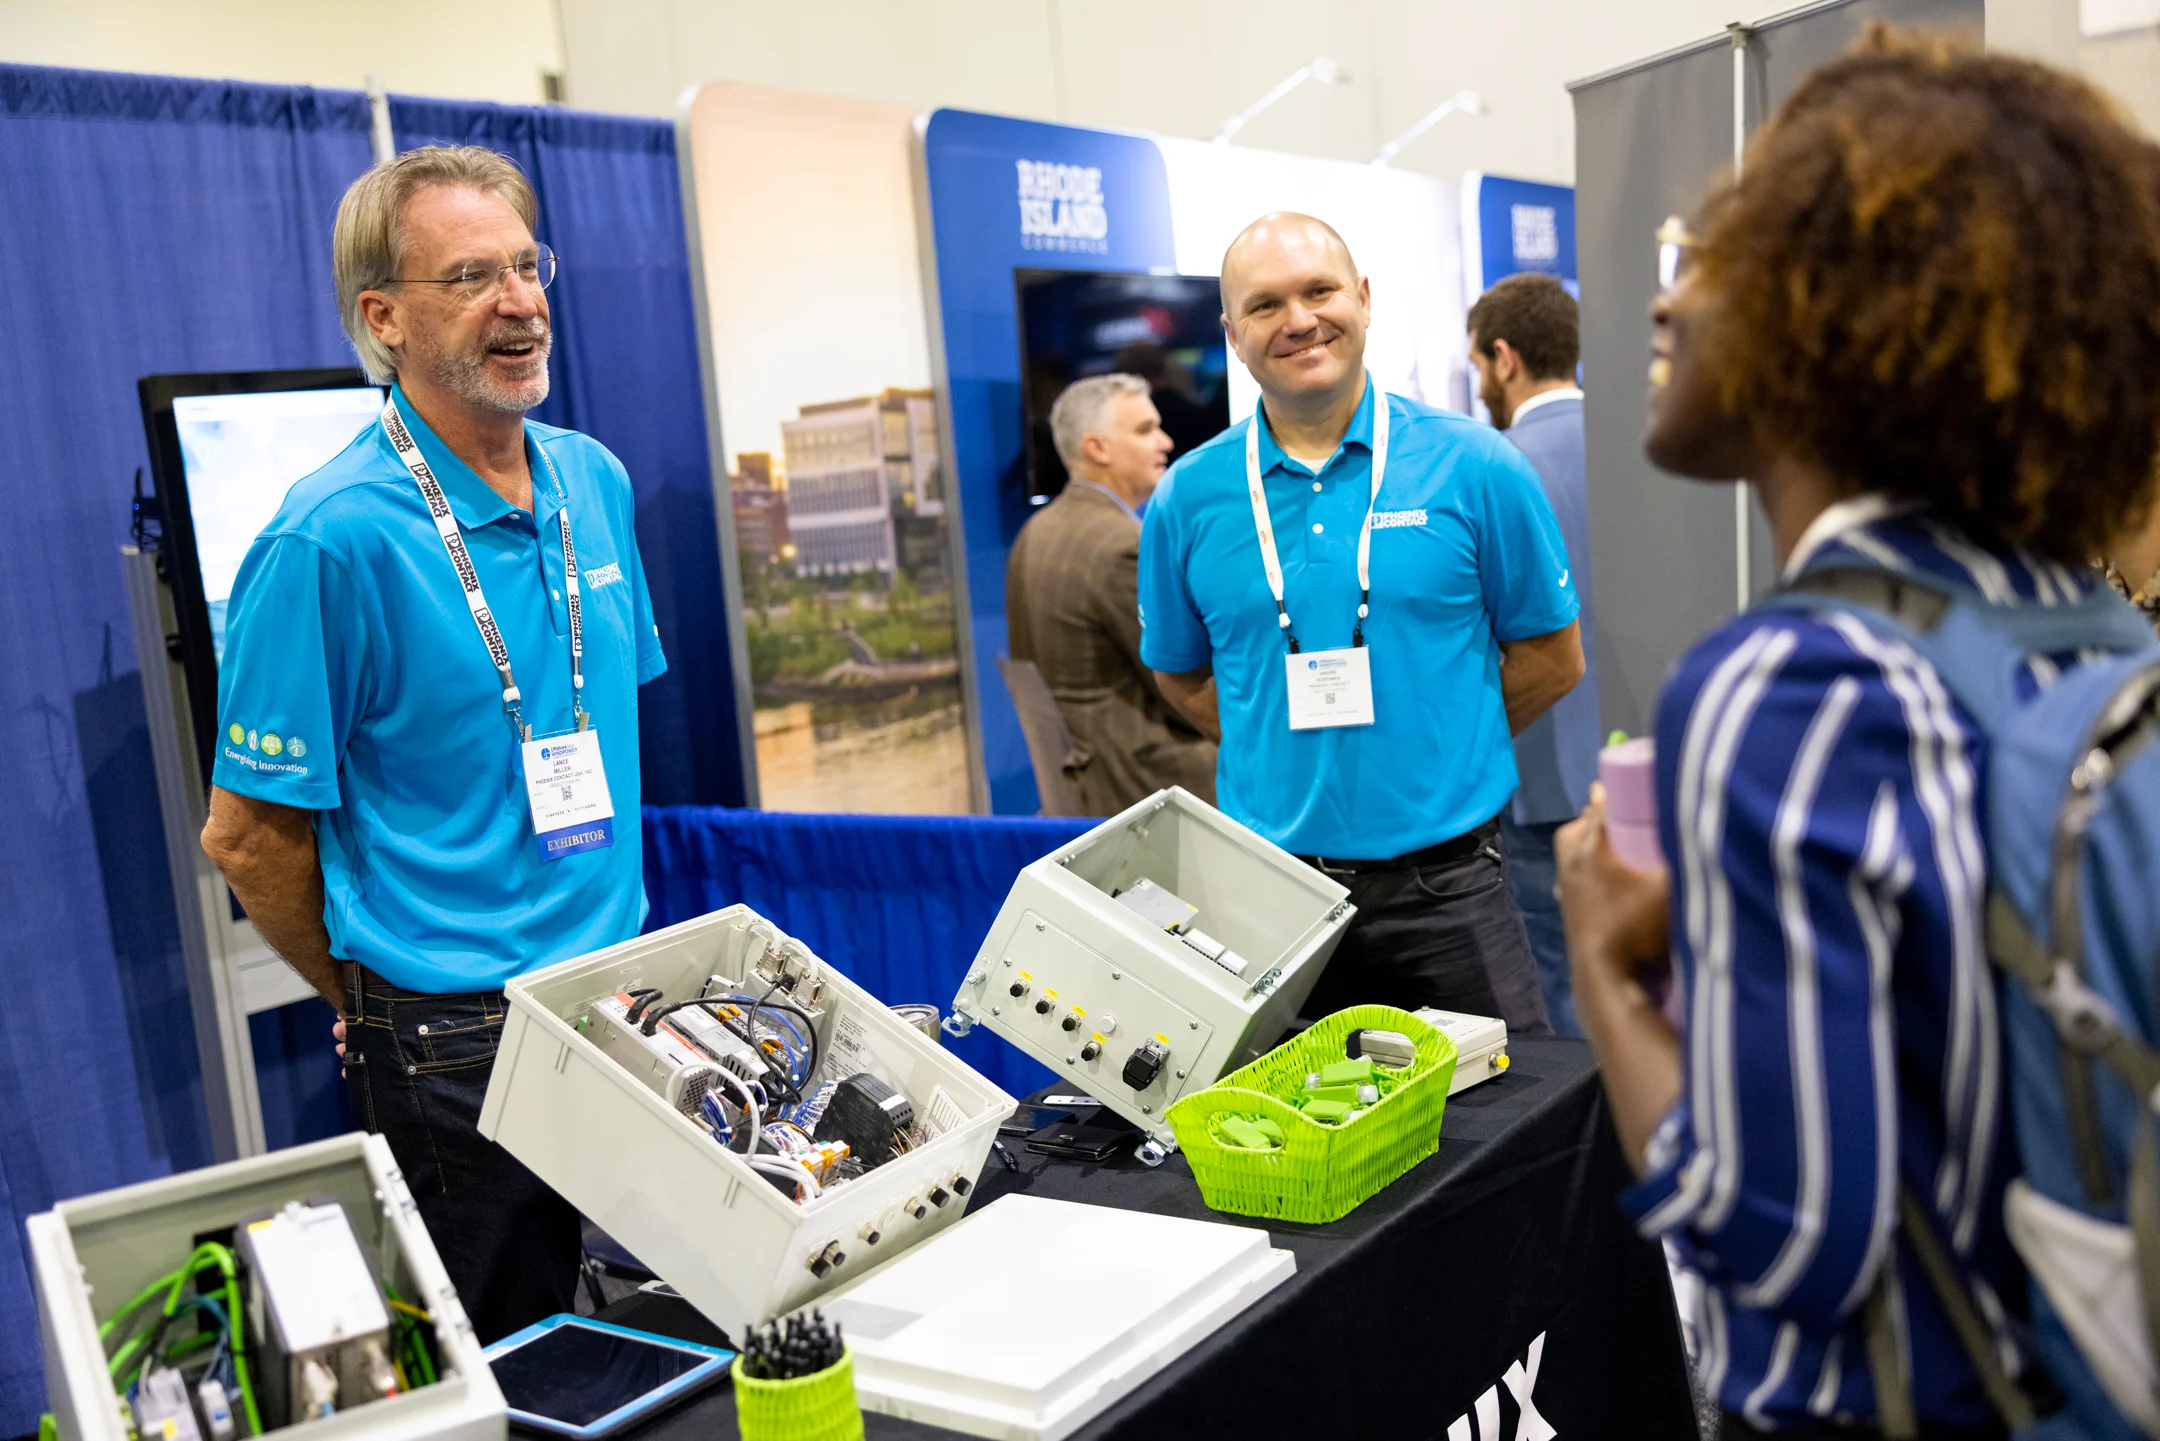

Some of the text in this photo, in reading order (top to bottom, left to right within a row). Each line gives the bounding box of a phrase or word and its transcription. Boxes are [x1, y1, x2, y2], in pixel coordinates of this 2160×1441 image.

[1019, 199, 1108, 239] ISLAND
[385, 420, 408, 453] CONTACT
[418, 476, 443, 518] CONTACT
[450, 549, 473, 593] CONTACT
[481, 623, 505, 667] CONTACT
[259, 760, 308, 774] Innovation
[553, 766, 571, 774] MILLER
[554, 772, 573, 781] CONTACT
[547, 829, 605, 852] EXHIBITOR
